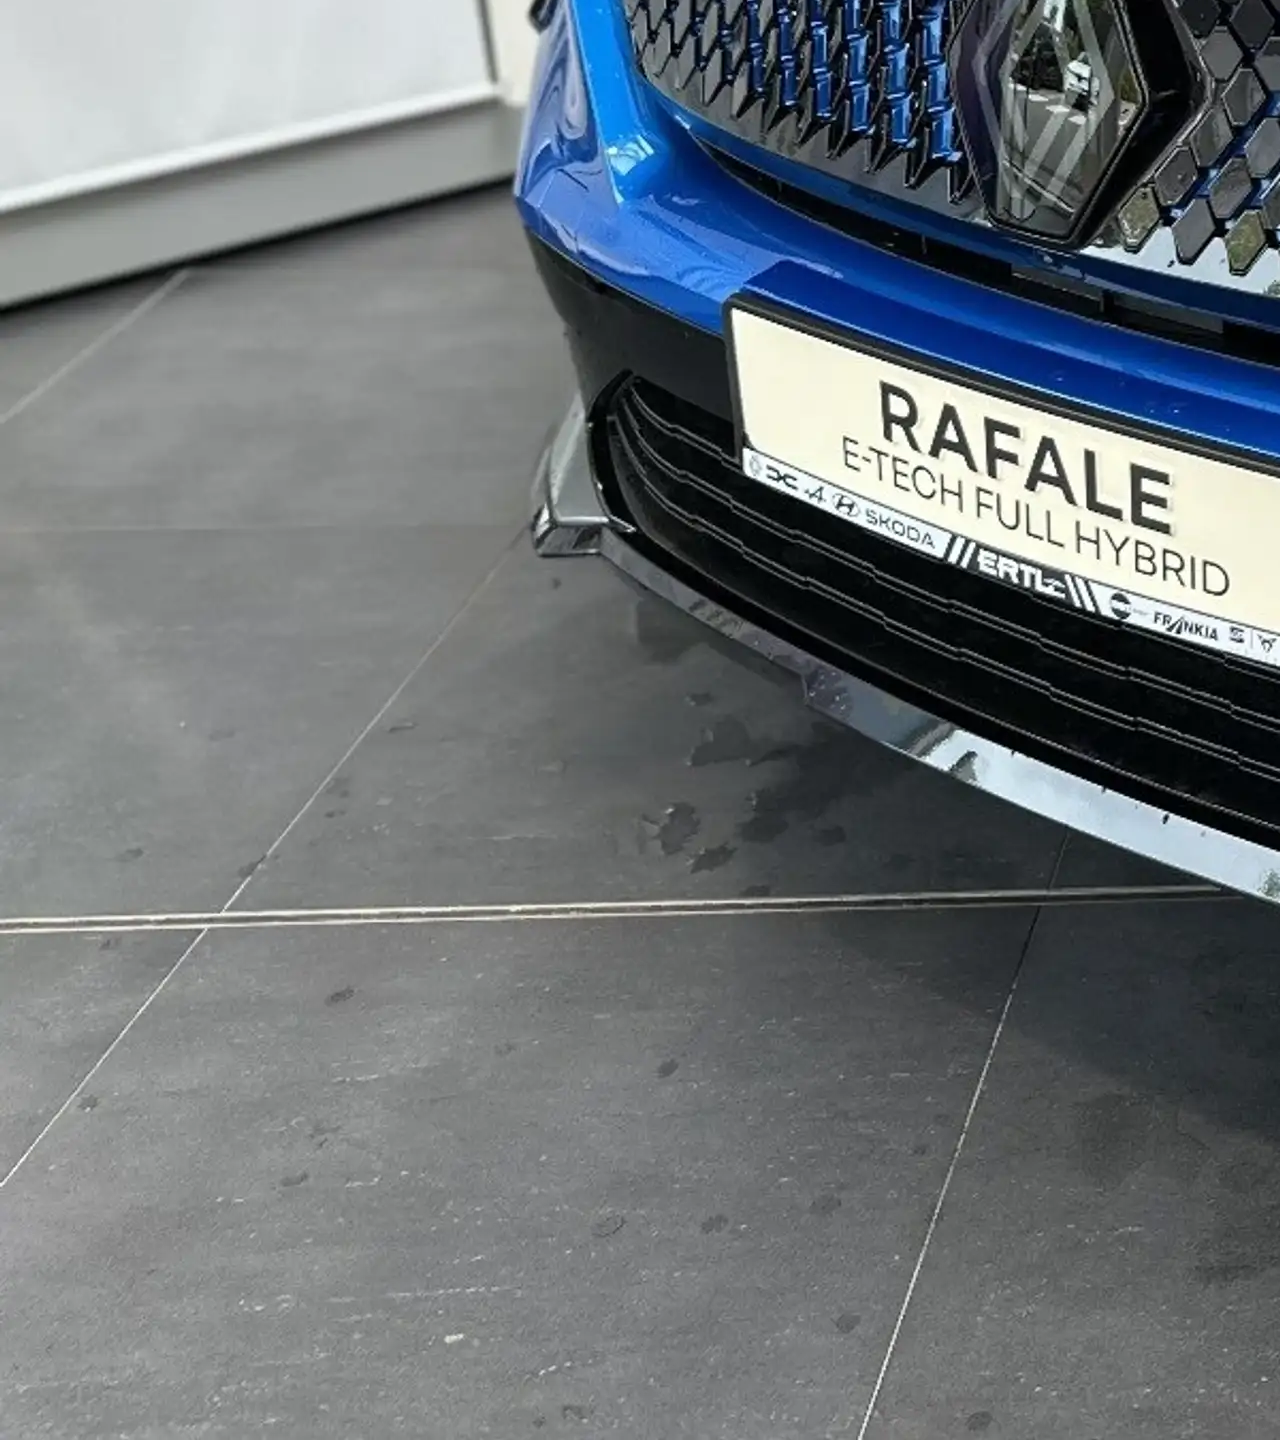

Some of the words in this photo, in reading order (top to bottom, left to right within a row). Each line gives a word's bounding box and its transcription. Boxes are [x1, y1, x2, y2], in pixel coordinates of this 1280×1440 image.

[842, 436, 963, 514] E-TECH
[975, 486, 1065, 549] FULL
[1076, 520, 1231, 598] HYBRID
[879, 380, 1173, 537] RAFALE
[1153, 611, 1219, 641] FRANKIA
